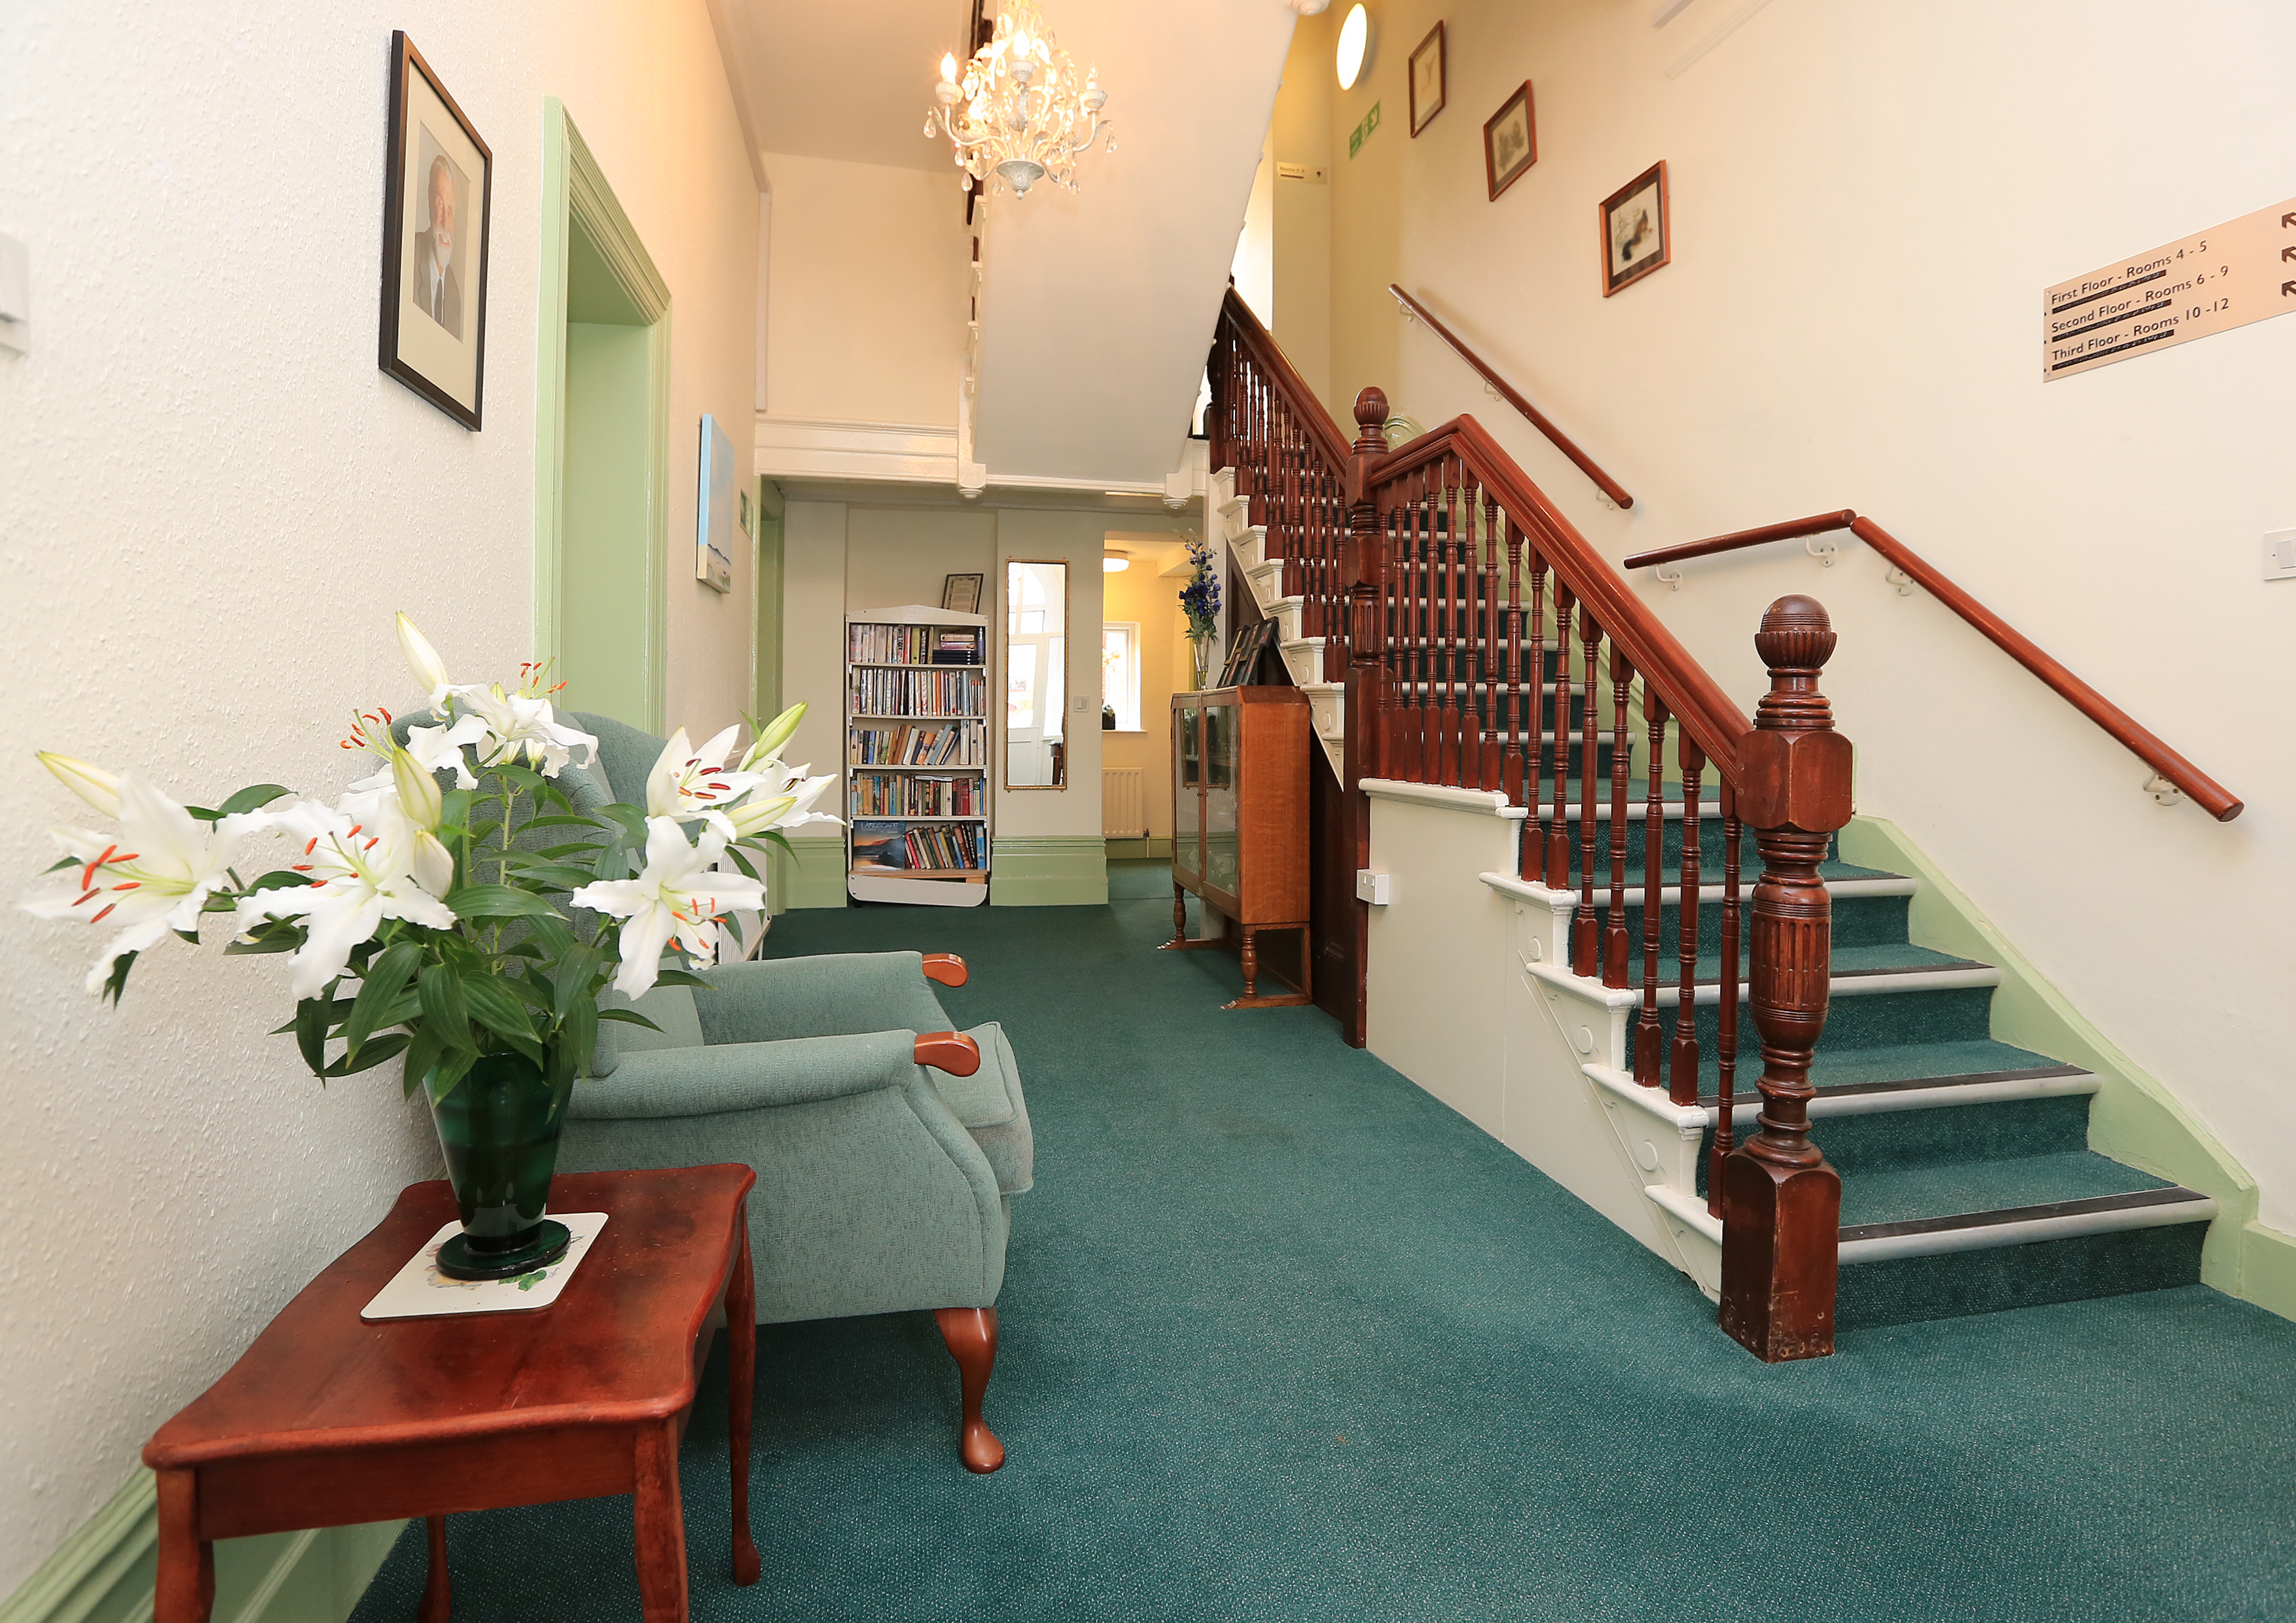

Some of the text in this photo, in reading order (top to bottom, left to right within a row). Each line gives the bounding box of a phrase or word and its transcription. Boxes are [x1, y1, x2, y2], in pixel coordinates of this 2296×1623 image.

[2051, 289, 2078, 305] First
[2081, 276, 2114, 294] Floor
[2126, 256, 2172, 278] Rooms
[2176, 248, 2185, 260] 4
[2198, 240, 2207, 253] 5
[2052, 310, 2094, 332] Second
[2099, 300, 2132, 317] Floor
[2145, 280, 2192, 302] Rooms
[2197, 274, 2204, 285] 6
[2220, 265, 2229, 277] 9
[2052, 342, 2084, 361] Third
[2088, 334, 2121, 350] Floor
[2134, 315, 2179, 336] Rooms
[2186, 306, 2200, 320] 10
